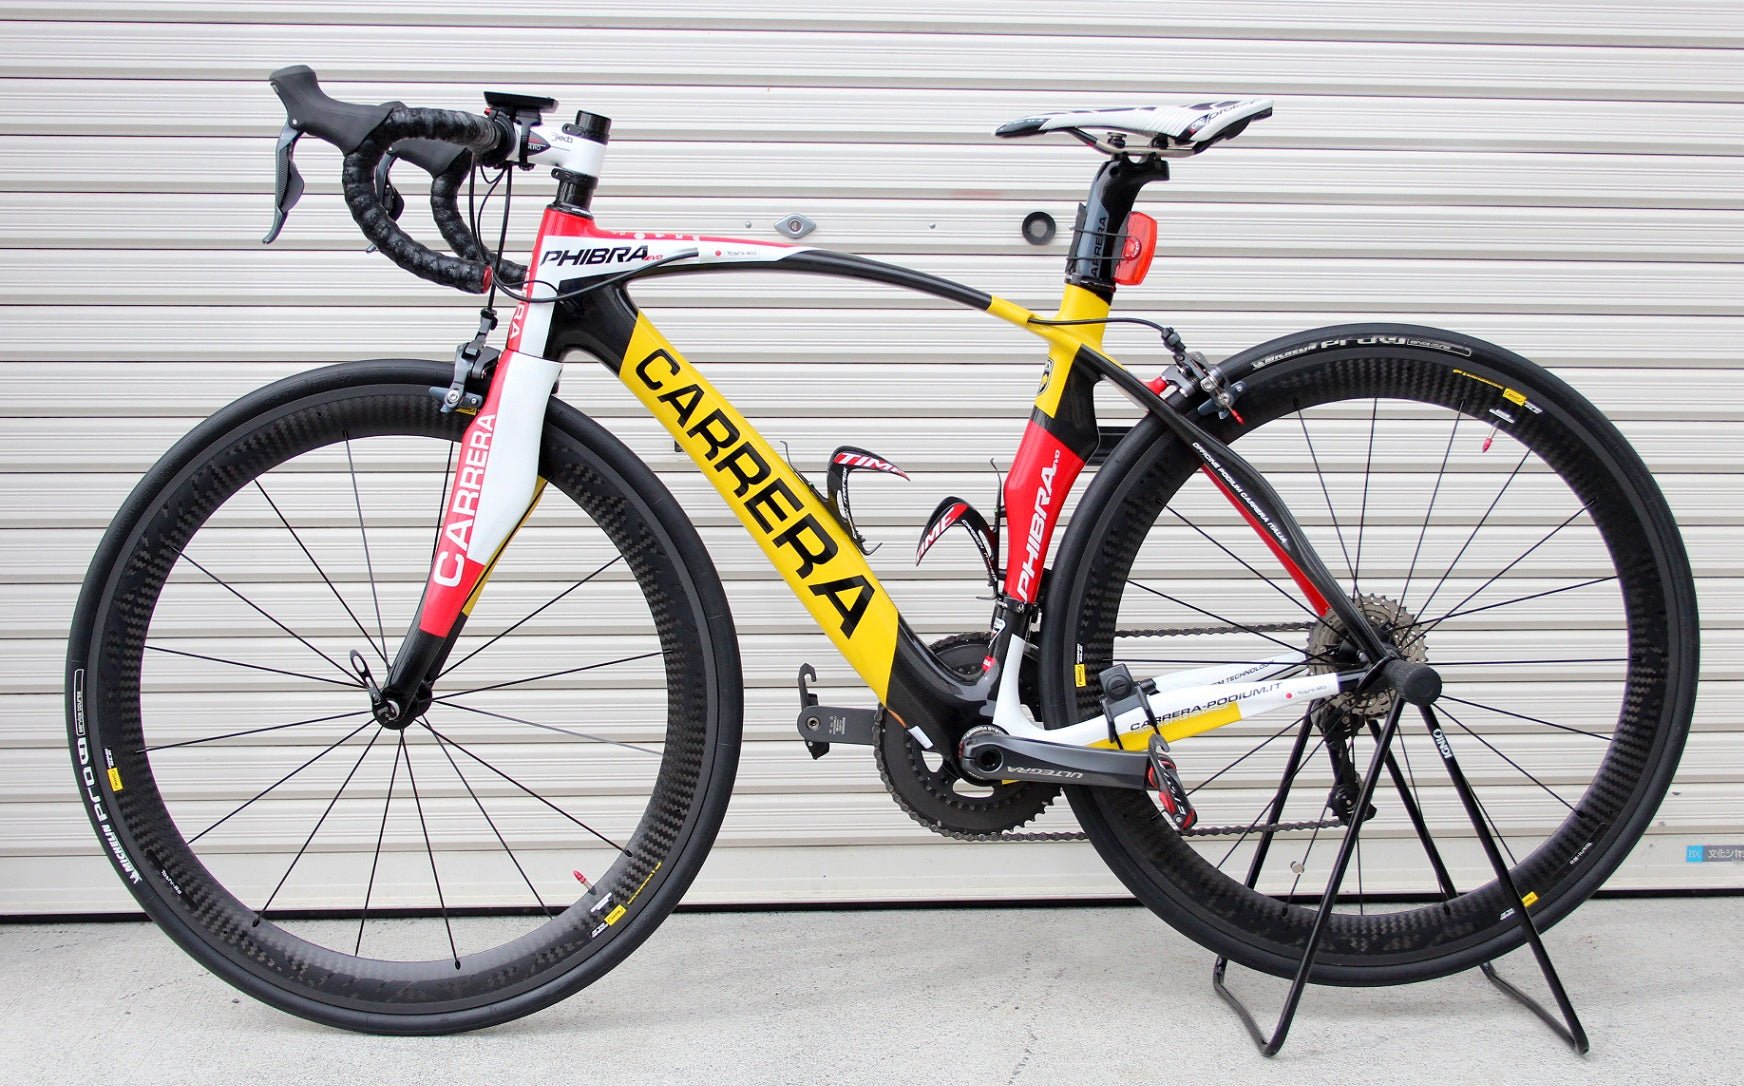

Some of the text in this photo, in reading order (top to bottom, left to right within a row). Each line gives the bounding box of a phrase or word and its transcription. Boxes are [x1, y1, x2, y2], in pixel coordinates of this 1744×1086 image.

[540, 245, 648, 267] PHIBRA
[1090, 216, 1107, 278] ARRERA
[433, 411, 496, 588] CARRERA
[635, 348, 876, 640] CARRERA
[1192, 442, 1287, 543] OFFICINE PODIUM CARRERA ITALIA
[1016, 466, 1055, 603] PHIBRA
[1007, 765, 1084, 779] ULTEGRA
[1433, 728, 1452, 759] IGNIO
[102, 824, 136, 876] MICHELIN
[1707, 848, 1744, 859] 文化シャ
